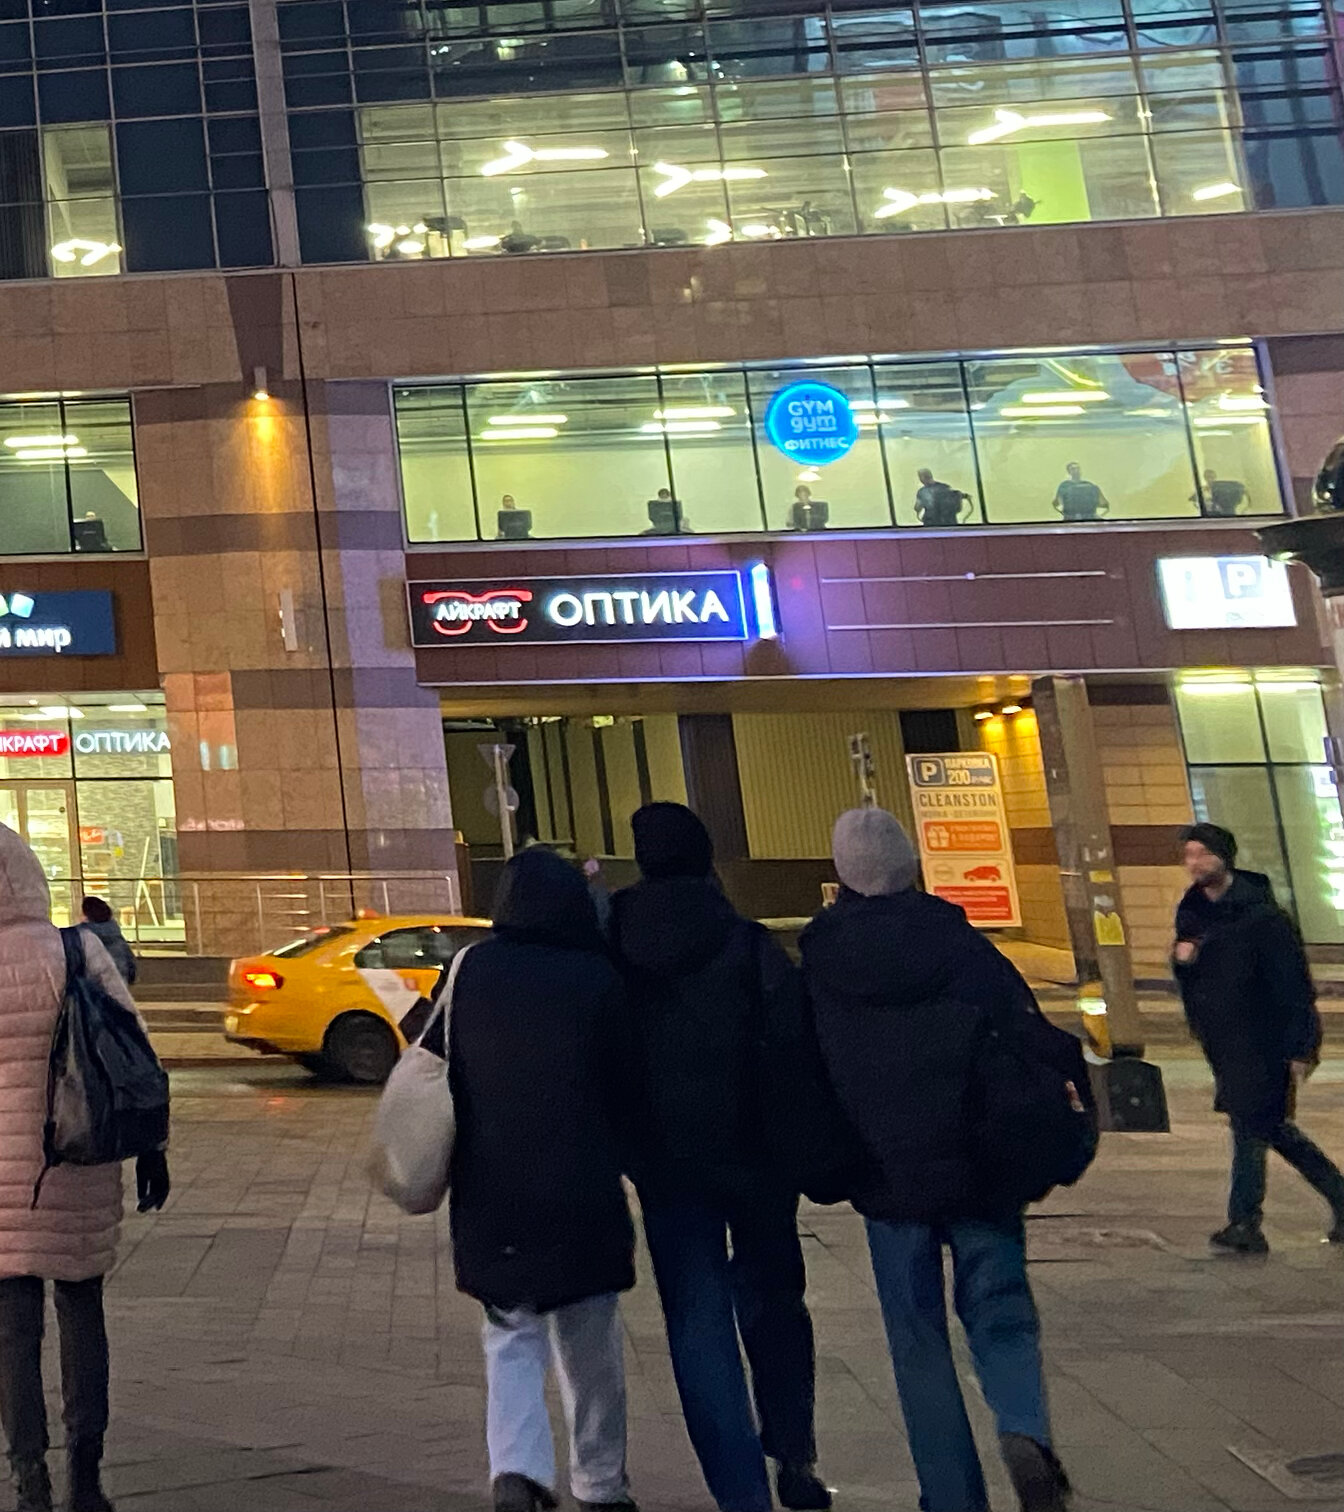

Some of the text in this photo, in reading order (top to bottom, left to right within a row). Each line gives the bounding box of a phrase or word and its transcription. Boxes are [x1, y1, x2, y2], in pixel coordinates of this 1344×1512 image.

[788, 400, 834, 416] GYM
[784, 437, 849, 450] ФИТНЕС
[437, 589, 728, 626] АЙКРАФТ ОПТИКА
[15, 628, 72, 653] мир
[76, 730, 171, 754] ОПТИКА
[947, 769, 971, 785] 200
[919, 793, 997, 807] CLEANSTON
